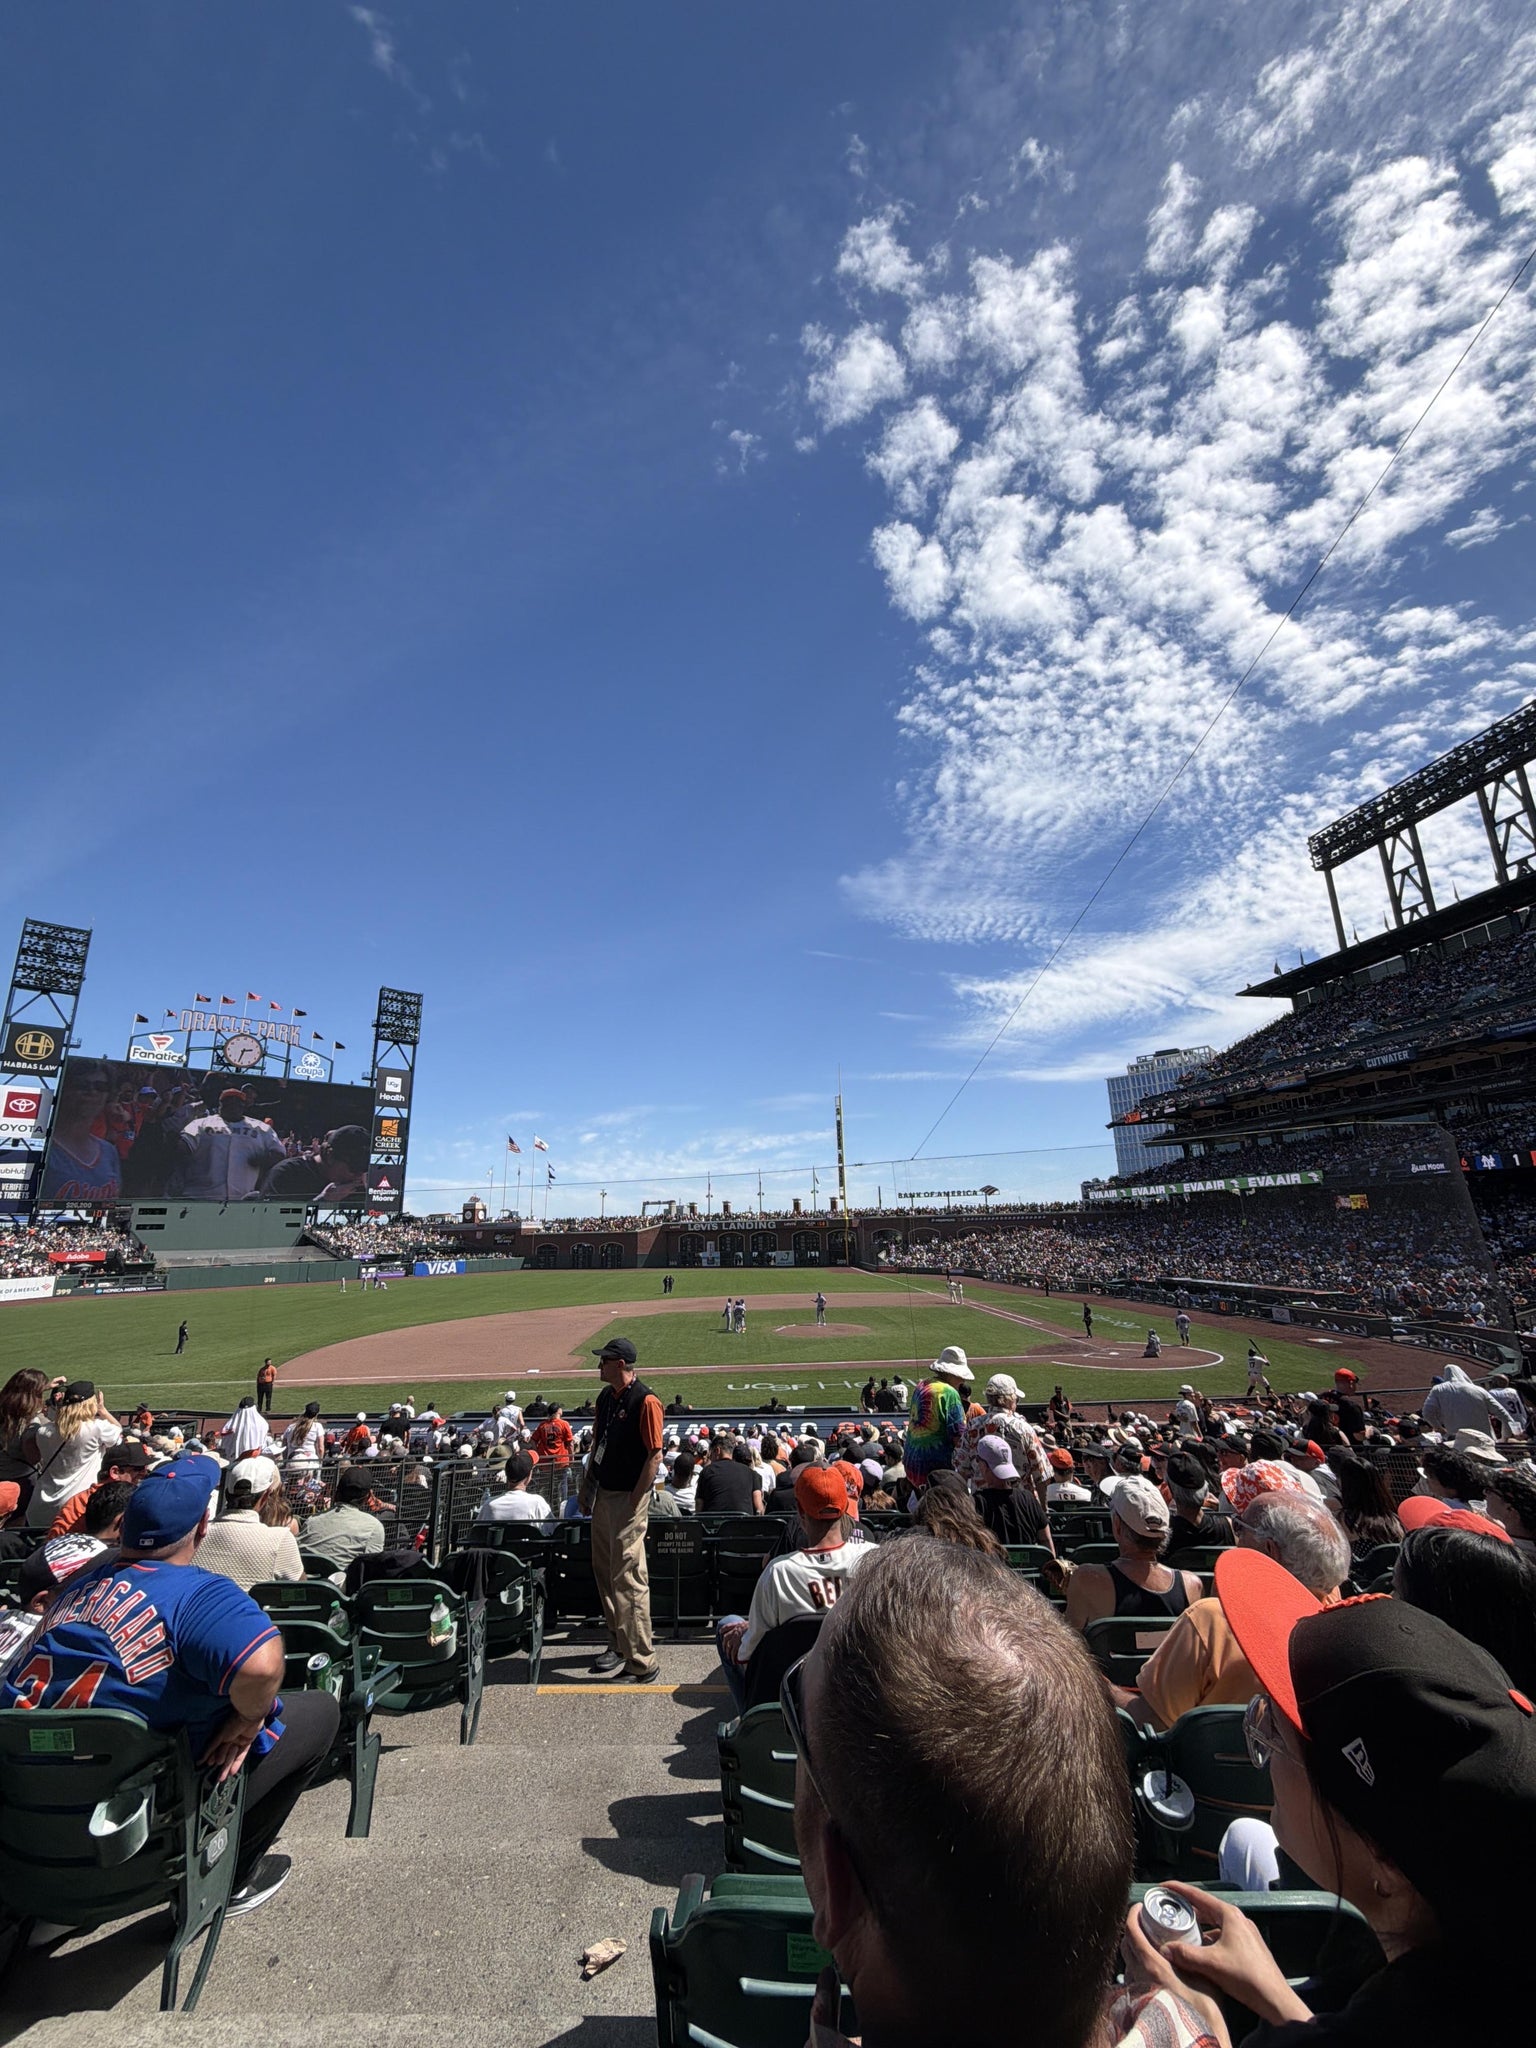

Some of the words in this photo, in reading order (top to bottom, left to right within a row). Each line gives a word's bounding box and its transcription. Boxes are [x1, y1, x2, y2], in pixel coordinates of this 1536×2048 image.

[180, 1009, 251, 1036] ORACLE
[256, 1022, 302, 1046] PARK
[132, 1047, 185, 1064] Fanatics
[1366, 1051, 1410, 1069] CUTWATER
[4, 1061, 38, 1070] HABBAS
[296, 1066, 325, 1078] coupa
[380, 1093, 405, 1102] Health
[1461, 1158, 1468, 1166] 6
[1512, 1154, 1520, 1166] 1
[1411, 1164, 1427, 1173] BLUE
[4, 1191, 30, 1199] TICKETS
[369, 1188, 398, 1196] Benjamin
[722, 1221, 777, 1230] LANDING
[428, 1262, 457, 1274] VISA
[56, 1288, 72, 1296] 399
[727, 1382, 810, 1392] UCSF
[664, 1532, 674, 1540] DO
[675, 1532, 687, 1540] NOT
